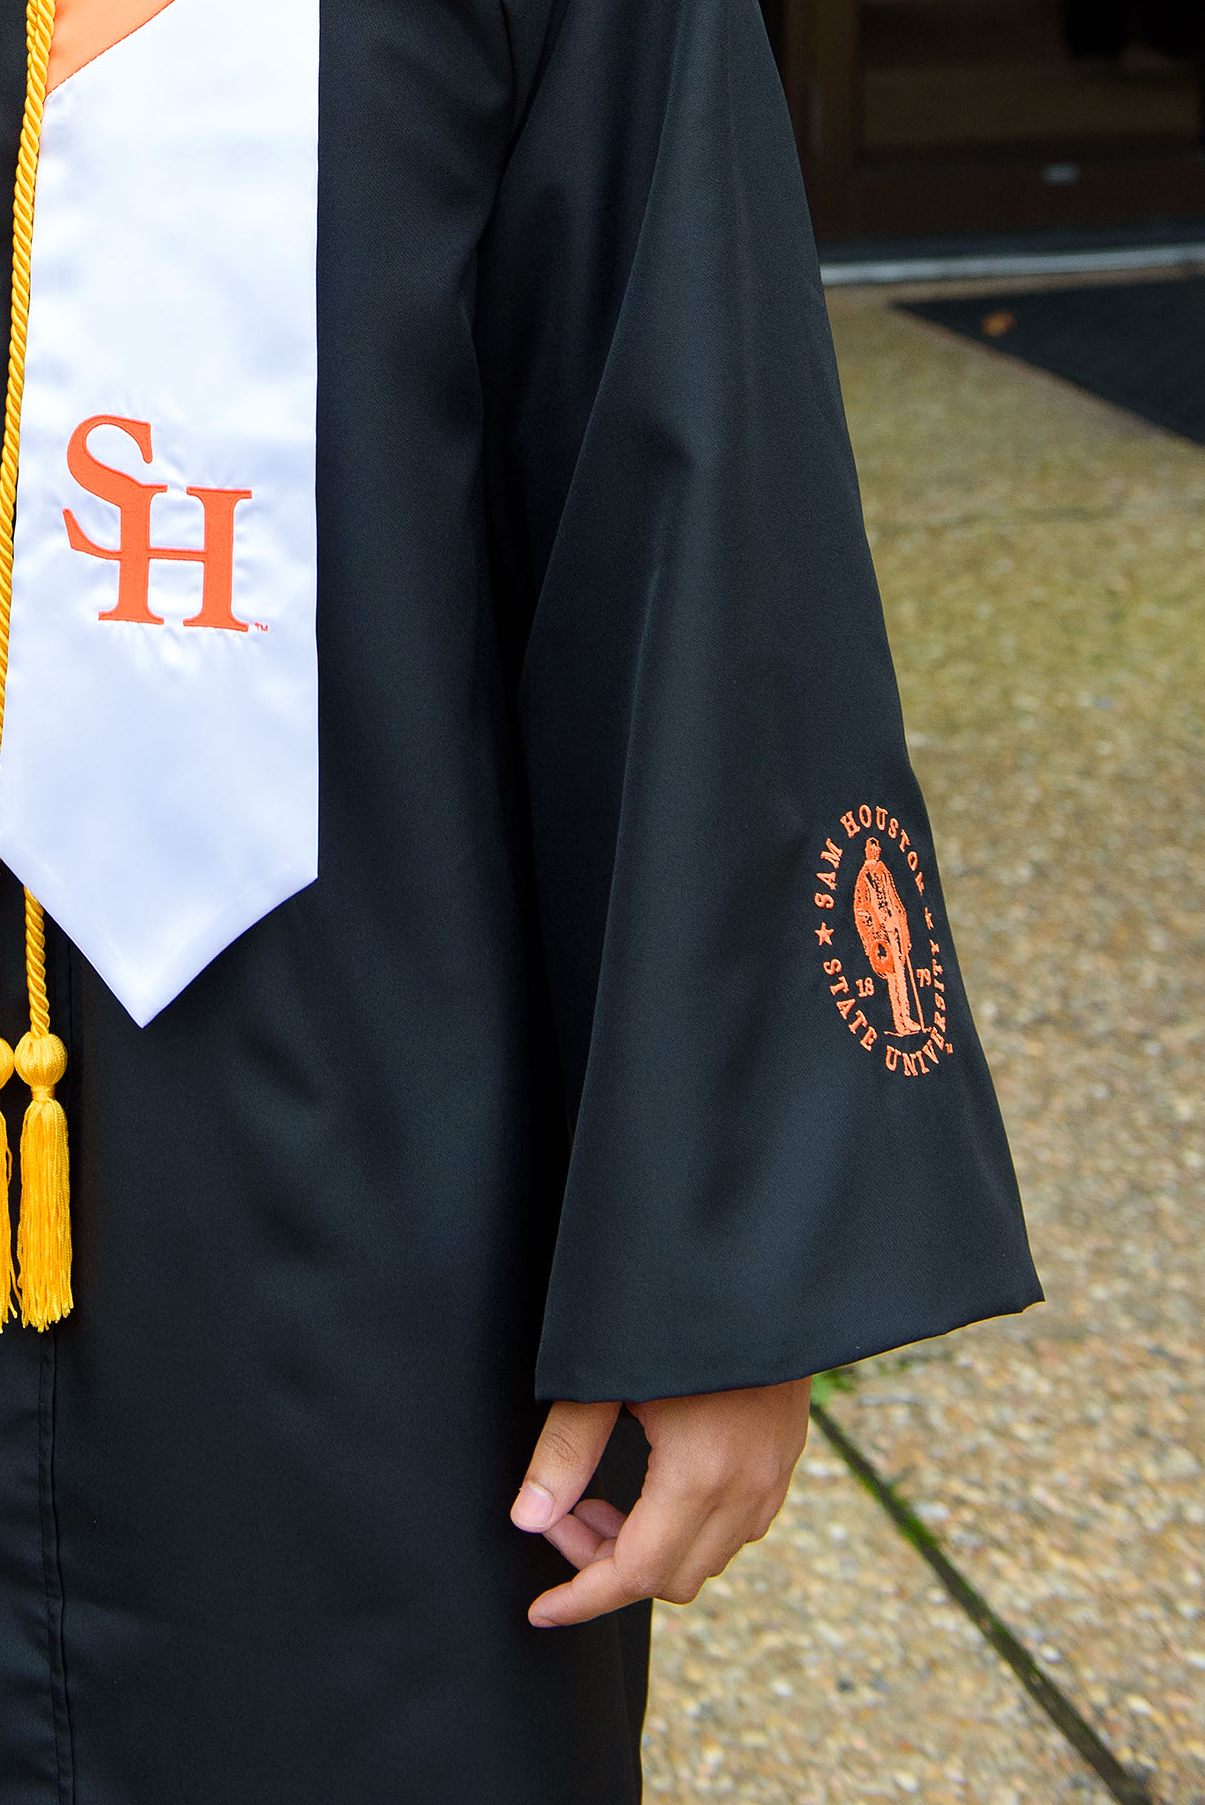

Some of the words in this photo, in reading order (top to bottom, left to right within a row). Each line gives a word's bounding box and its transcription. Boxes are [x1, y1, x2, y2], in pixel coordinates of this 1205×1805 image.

[62, 413, 253, 633] SH
[813, 837, 844, 910] SAM
[822, 957, 879, 1052] STATE
[855, 976, 876, 998] 18
